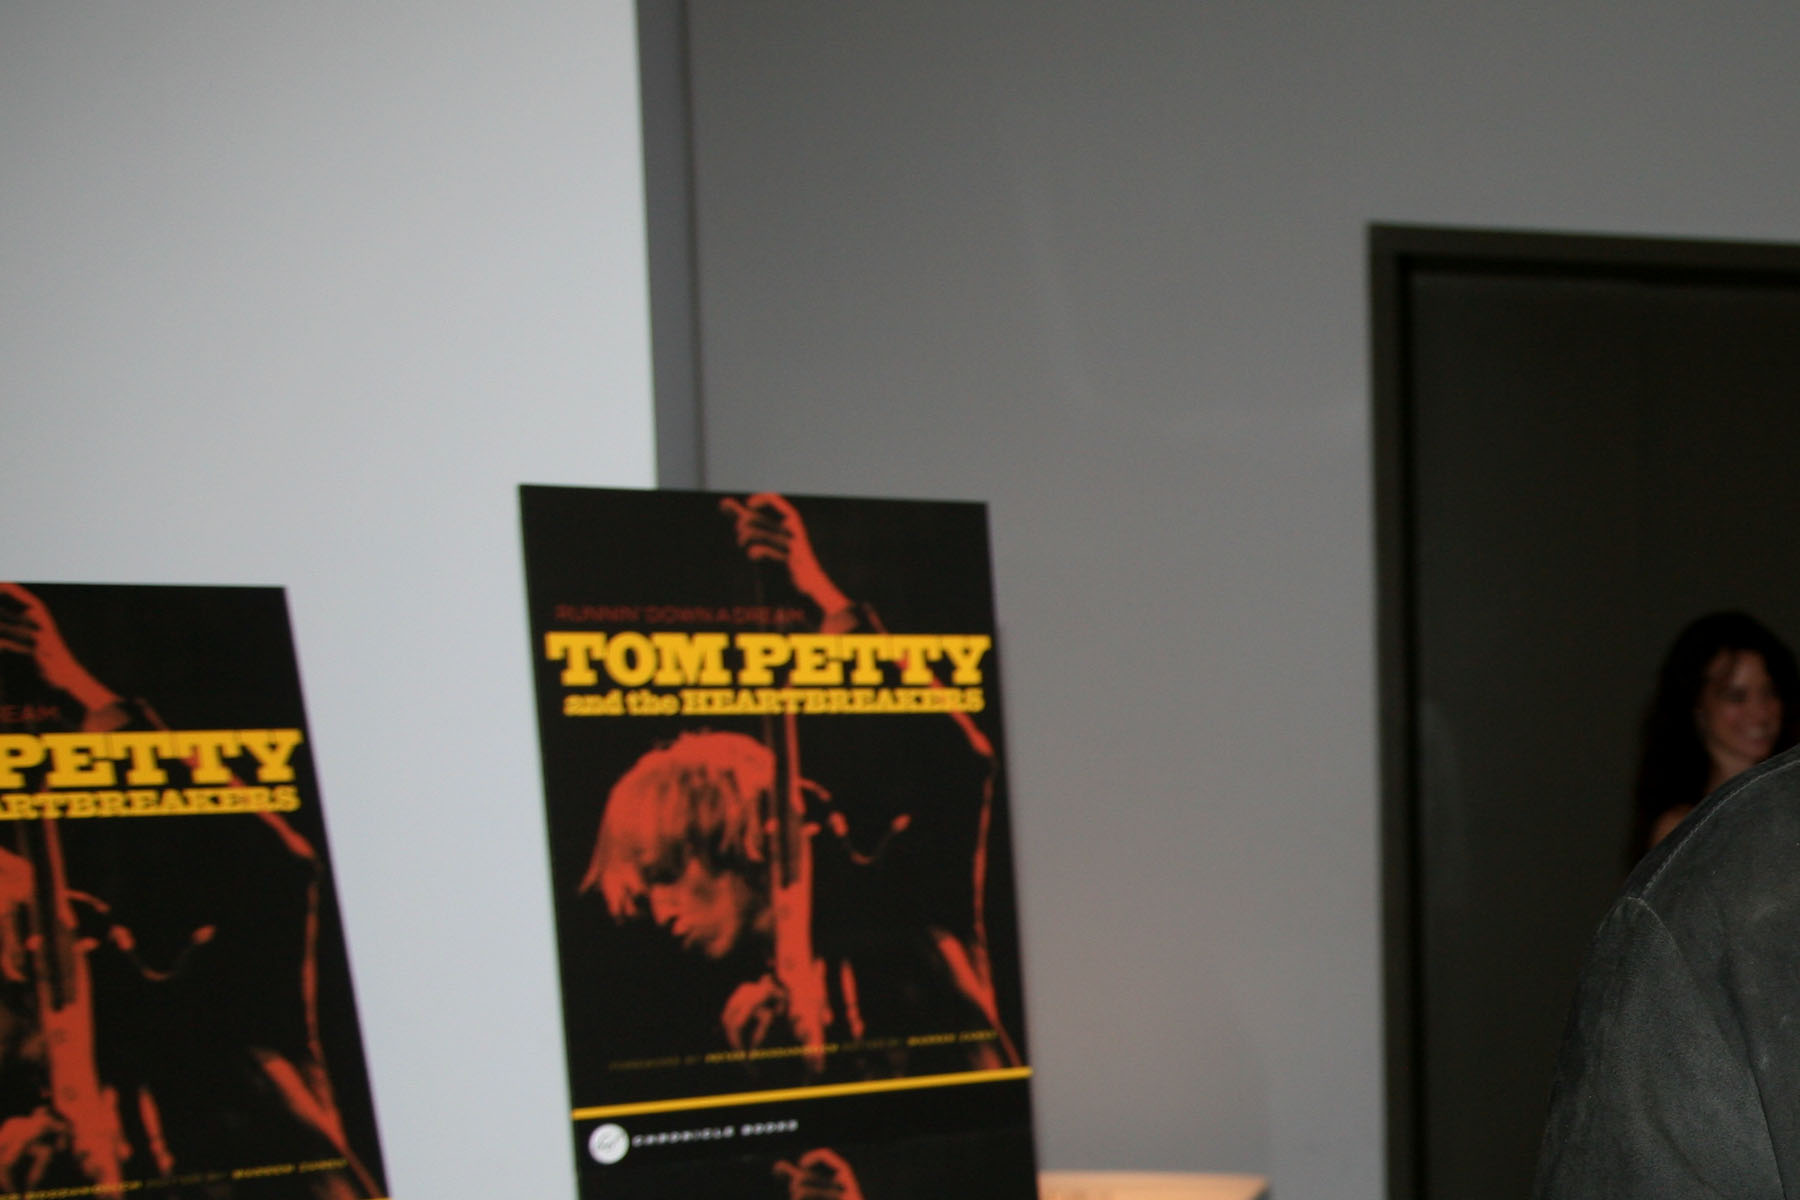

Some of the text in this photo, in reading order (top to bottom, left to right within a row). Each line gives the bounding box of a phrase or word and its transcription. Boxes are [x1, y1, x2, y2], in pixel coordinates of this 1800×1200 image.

[544, 630, 991, 688] TOM PETTY
[562, 688, 985, 717] and the HEARTBREAKERS
[0, 728, 303, 790] PETTY
[0, 785, 302, 821] RTBREAKERS
